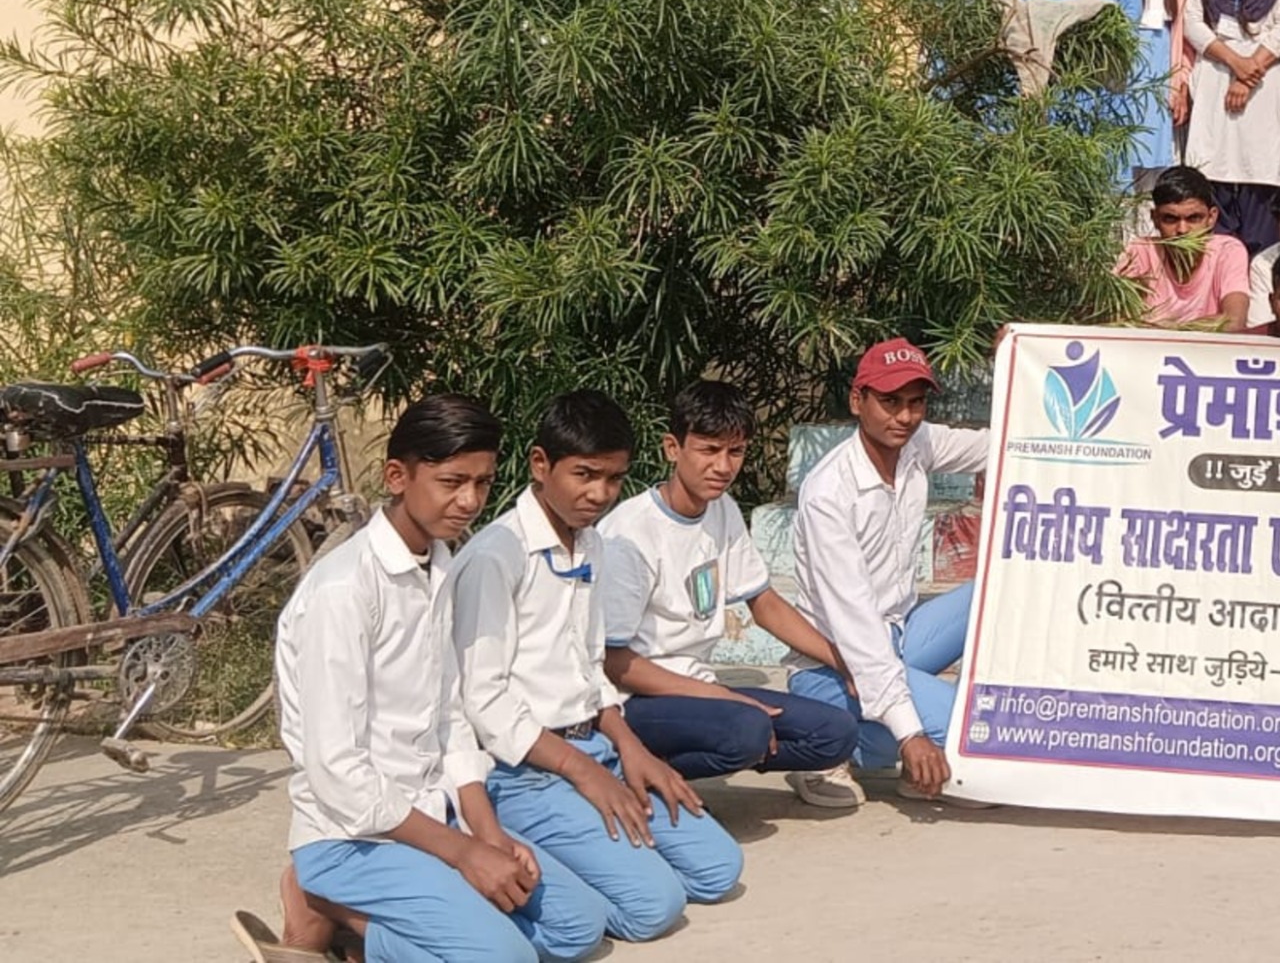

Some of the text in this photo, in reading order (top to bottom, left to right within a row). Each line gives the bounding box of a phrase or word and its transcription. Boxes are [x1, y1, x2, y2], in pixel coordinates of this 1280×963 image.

[1006, 441, 1152, 460] PREMANSH FOUNDATION
[1001, 484, 1111, 565] वित्तीय
[1121, 508, 1258, 574] साक्षरता
[1088, 642, 1139, 673] हमारे
[1146, 651, 1197, 676] साथ
